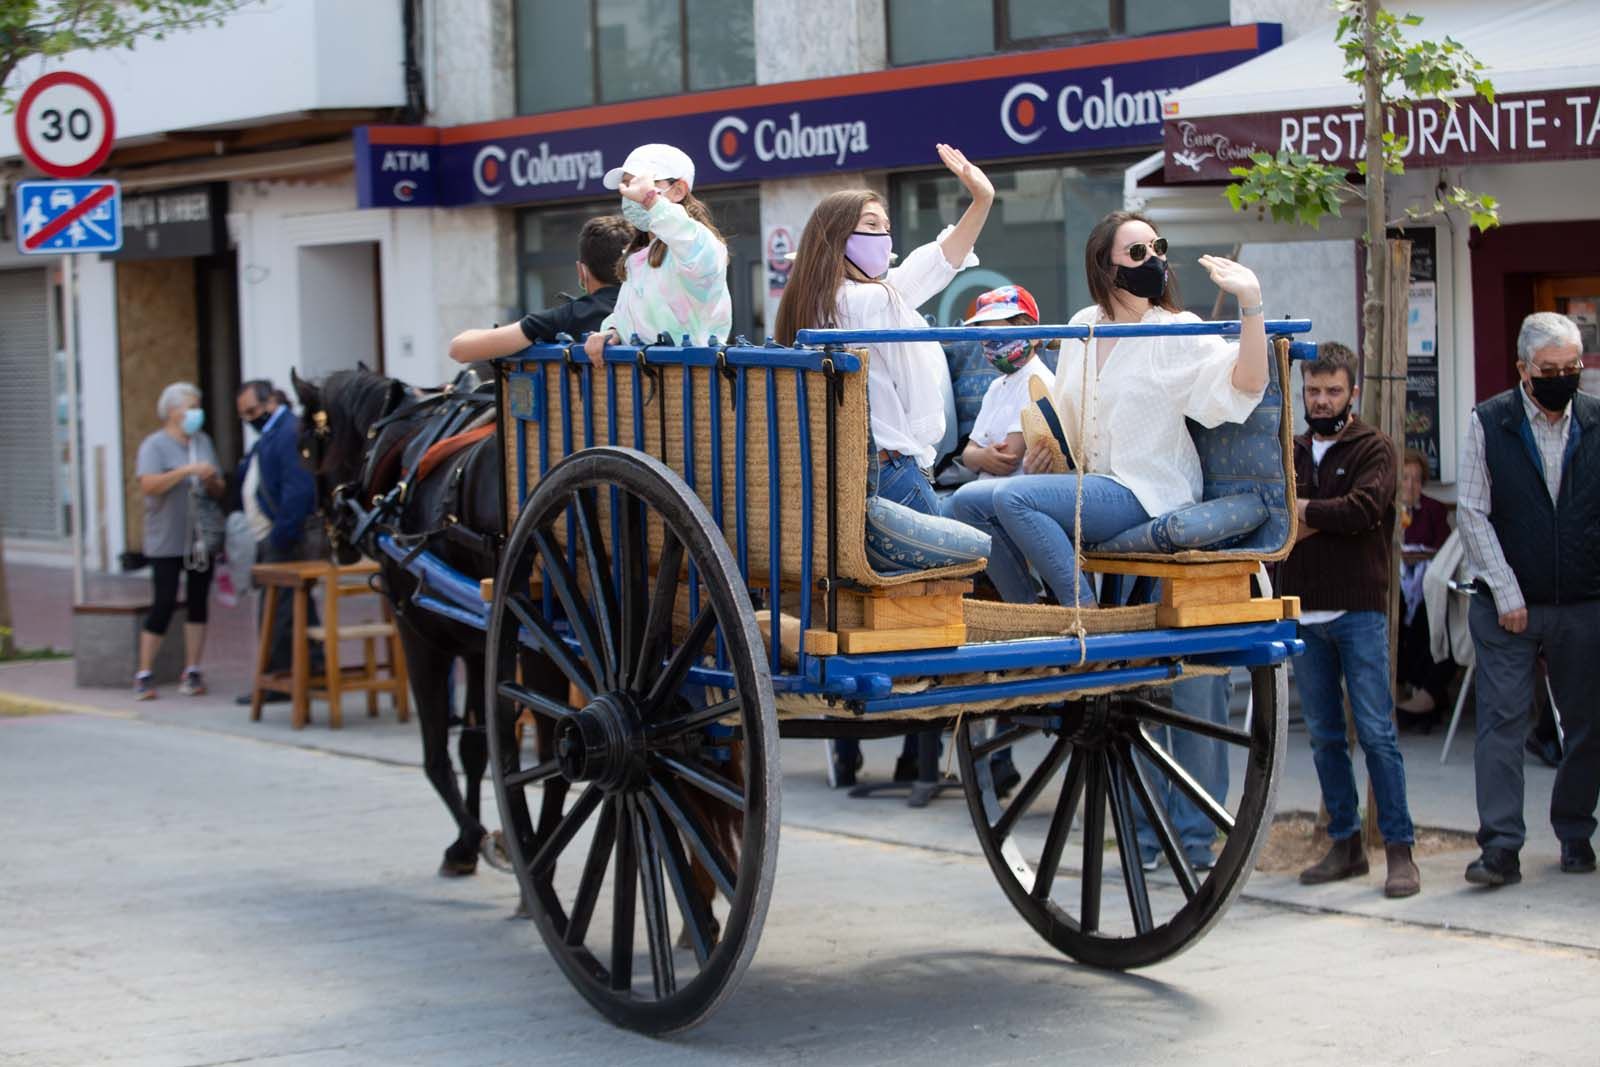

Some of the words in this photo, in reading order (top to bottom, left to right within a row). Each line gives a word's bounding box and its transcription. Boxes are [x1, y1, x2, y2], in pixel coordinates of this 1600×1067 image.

[42, 109, 91, 142] 30
[754, 112, 870, 165] Colonya
[1281, 99, 1547, 161] RESTURANTE
[382, 151, 430, 171] ATM
[510, 142, 604, 191] Colonya
